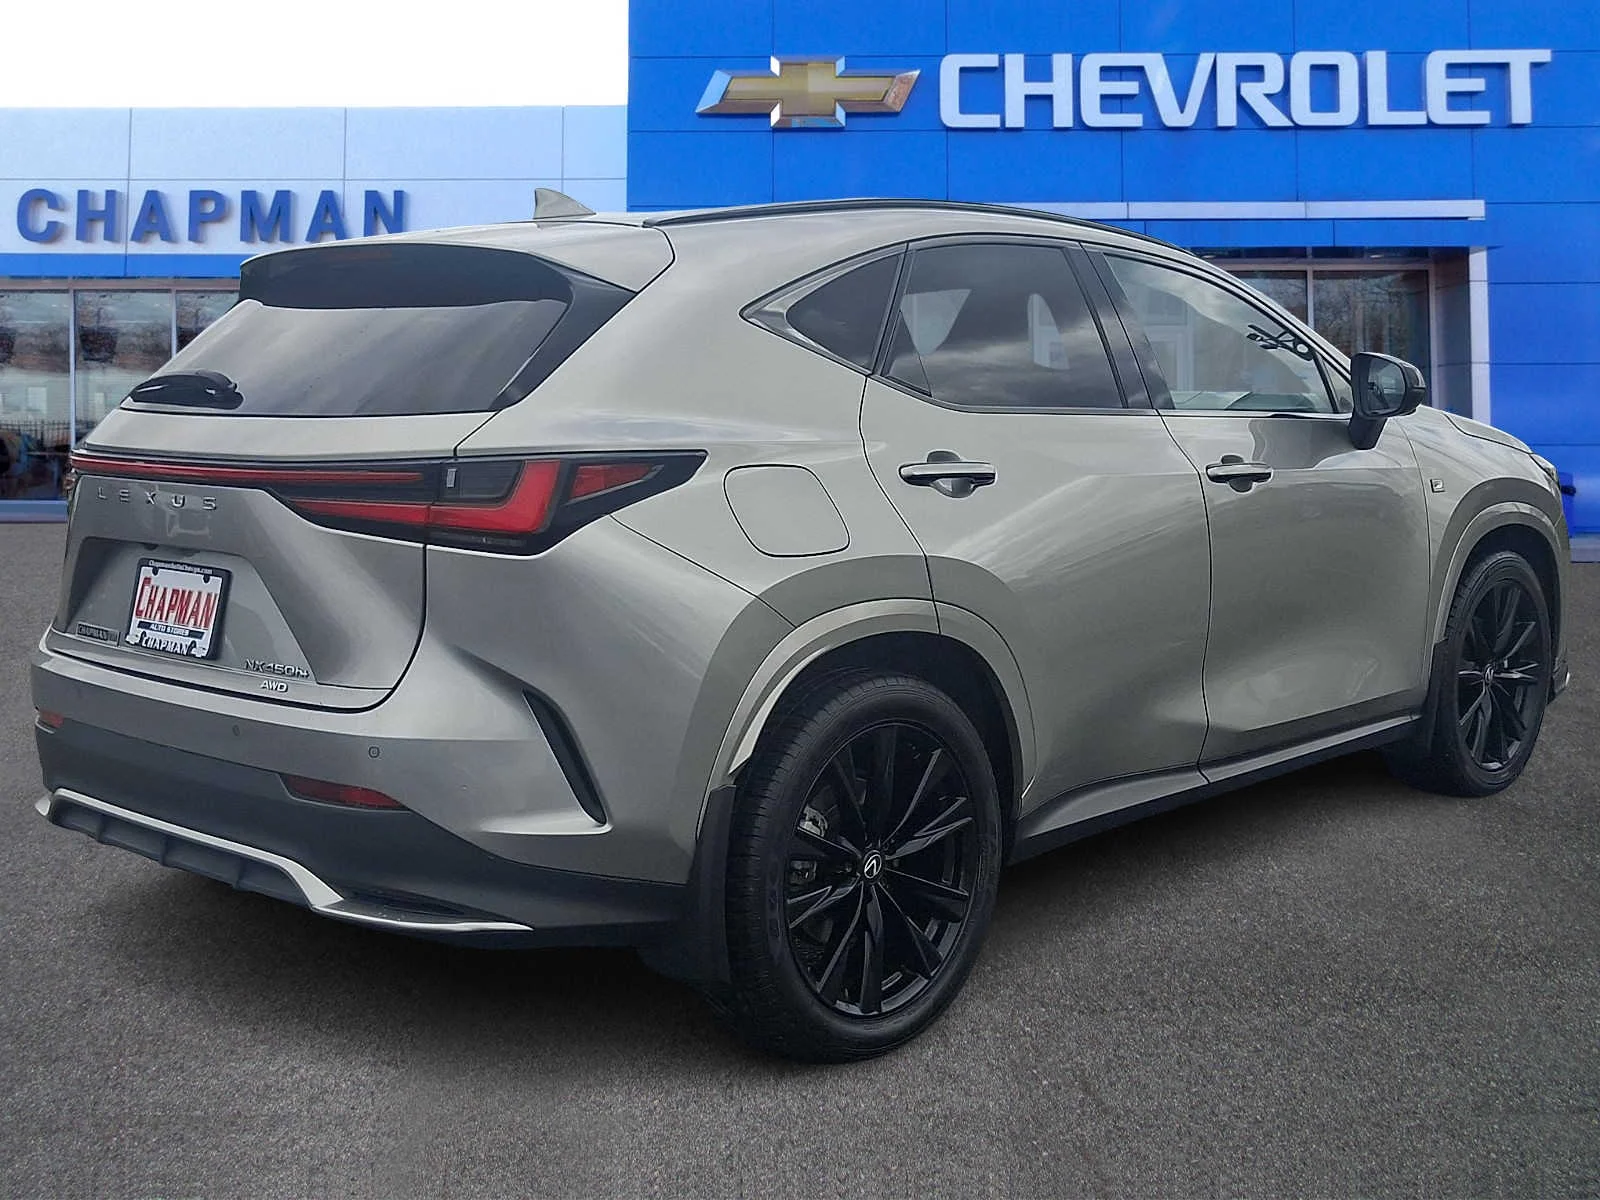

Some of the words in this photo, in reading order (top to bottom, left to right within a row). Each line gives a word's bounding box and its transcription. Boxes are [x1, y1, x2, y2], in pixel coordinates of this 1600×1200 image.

[939, 49, 1552, 128] CHEVROLET
[17, 188, 408, 243] CHAPMAN
[98, 487, 217, 510] LEXUS
[135, 577, 218, 630] CHAPMAN
[141, 635, 189, 656] CHAPMAN
[261, 680, 288, 692] AWD
